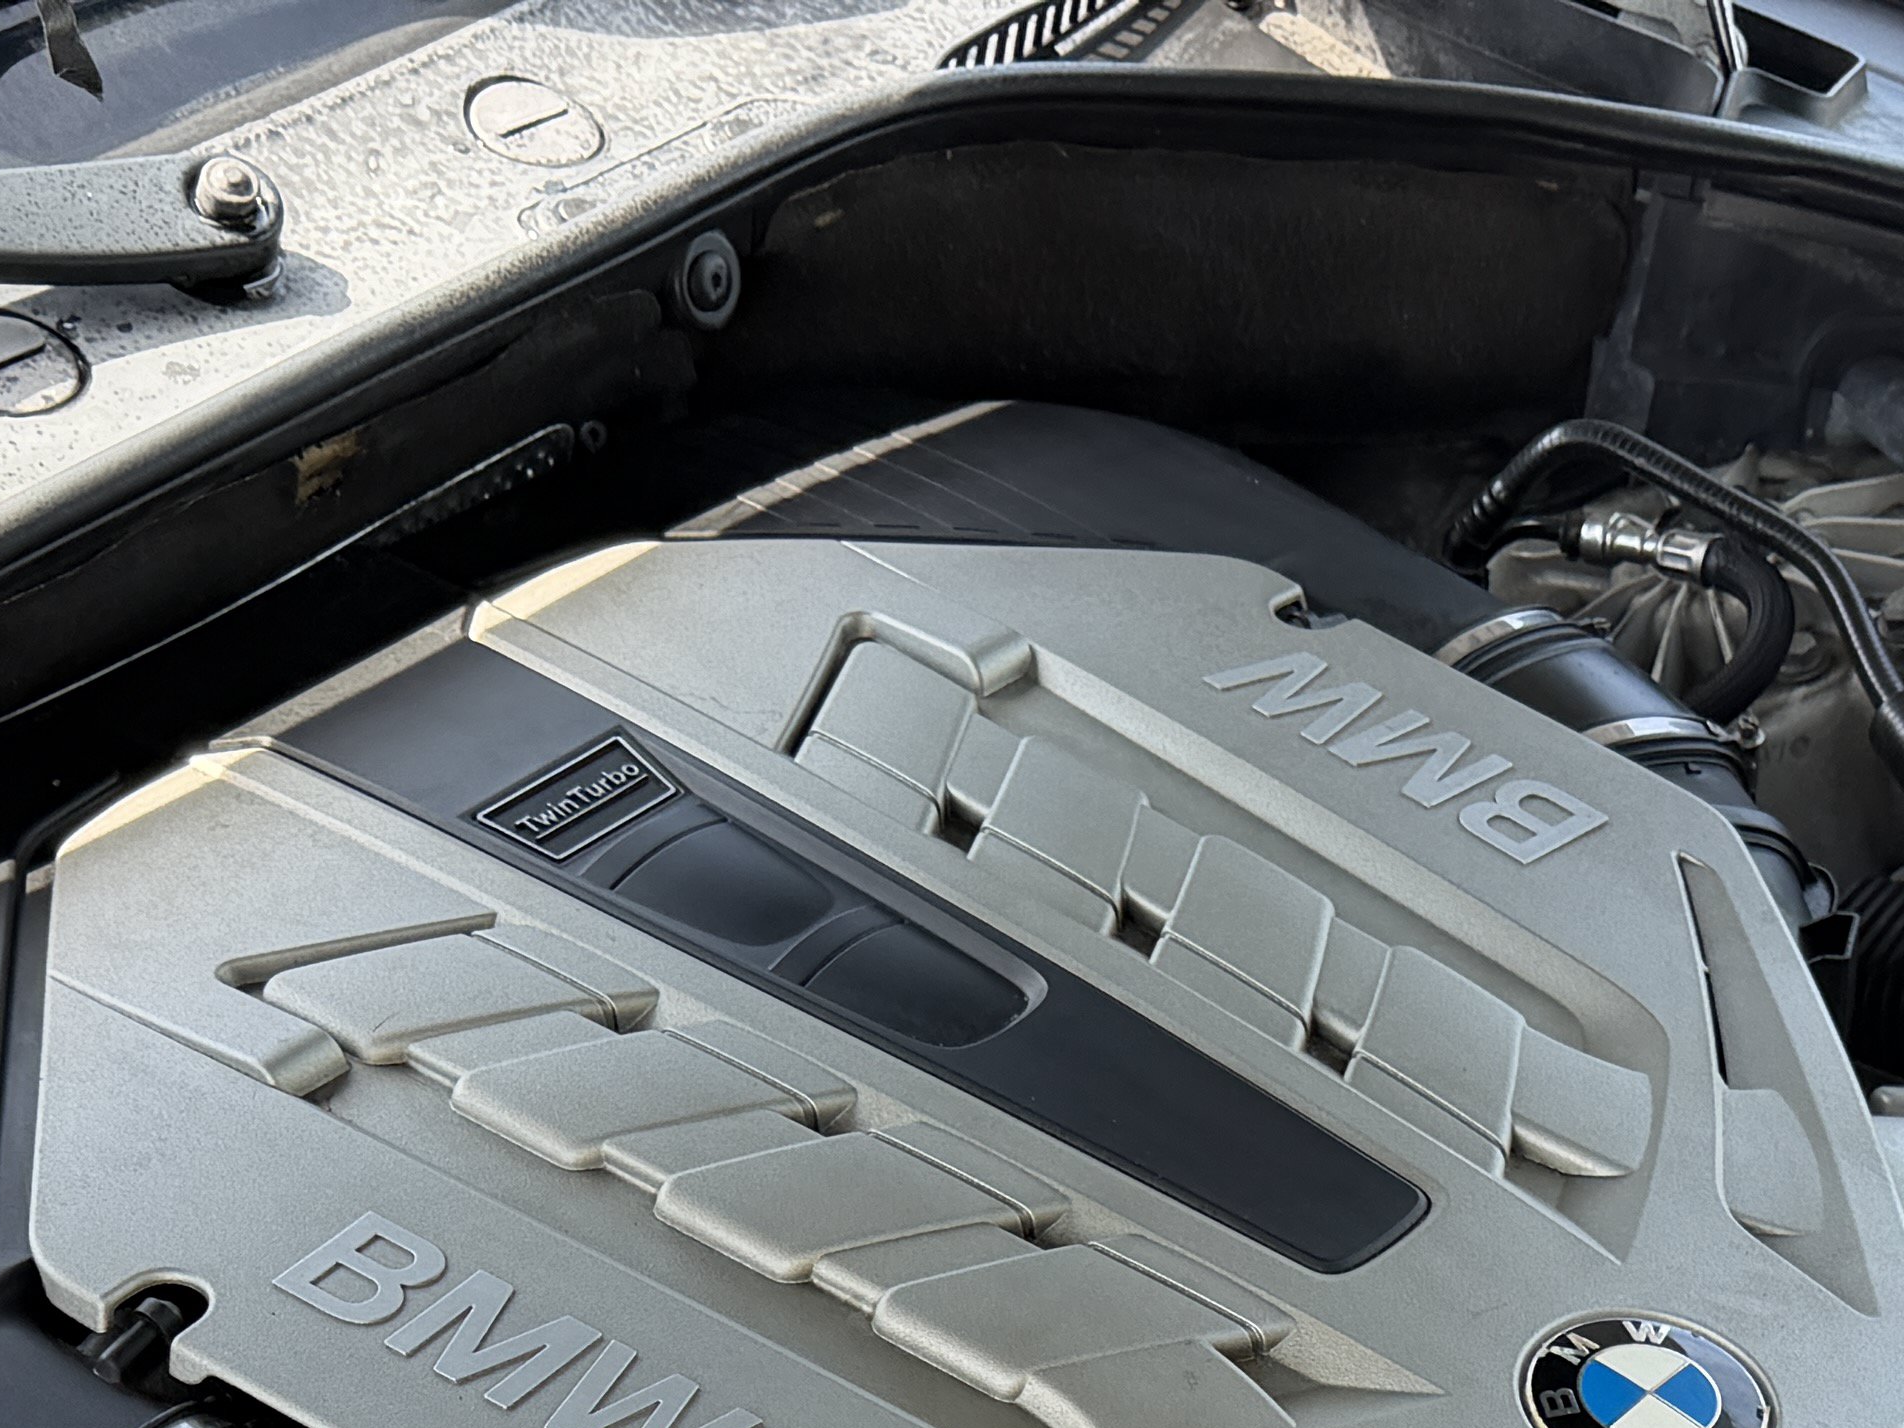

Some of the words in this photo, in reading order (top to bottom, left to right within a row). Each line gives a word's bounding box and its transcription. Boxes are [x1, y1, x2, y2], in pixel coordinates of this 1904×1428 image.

[515, 763, 640, 833] TwinTurbo
[1203, 652, 1609, 864] BMW
[1540, 1319, 1672, 1419] BMW
